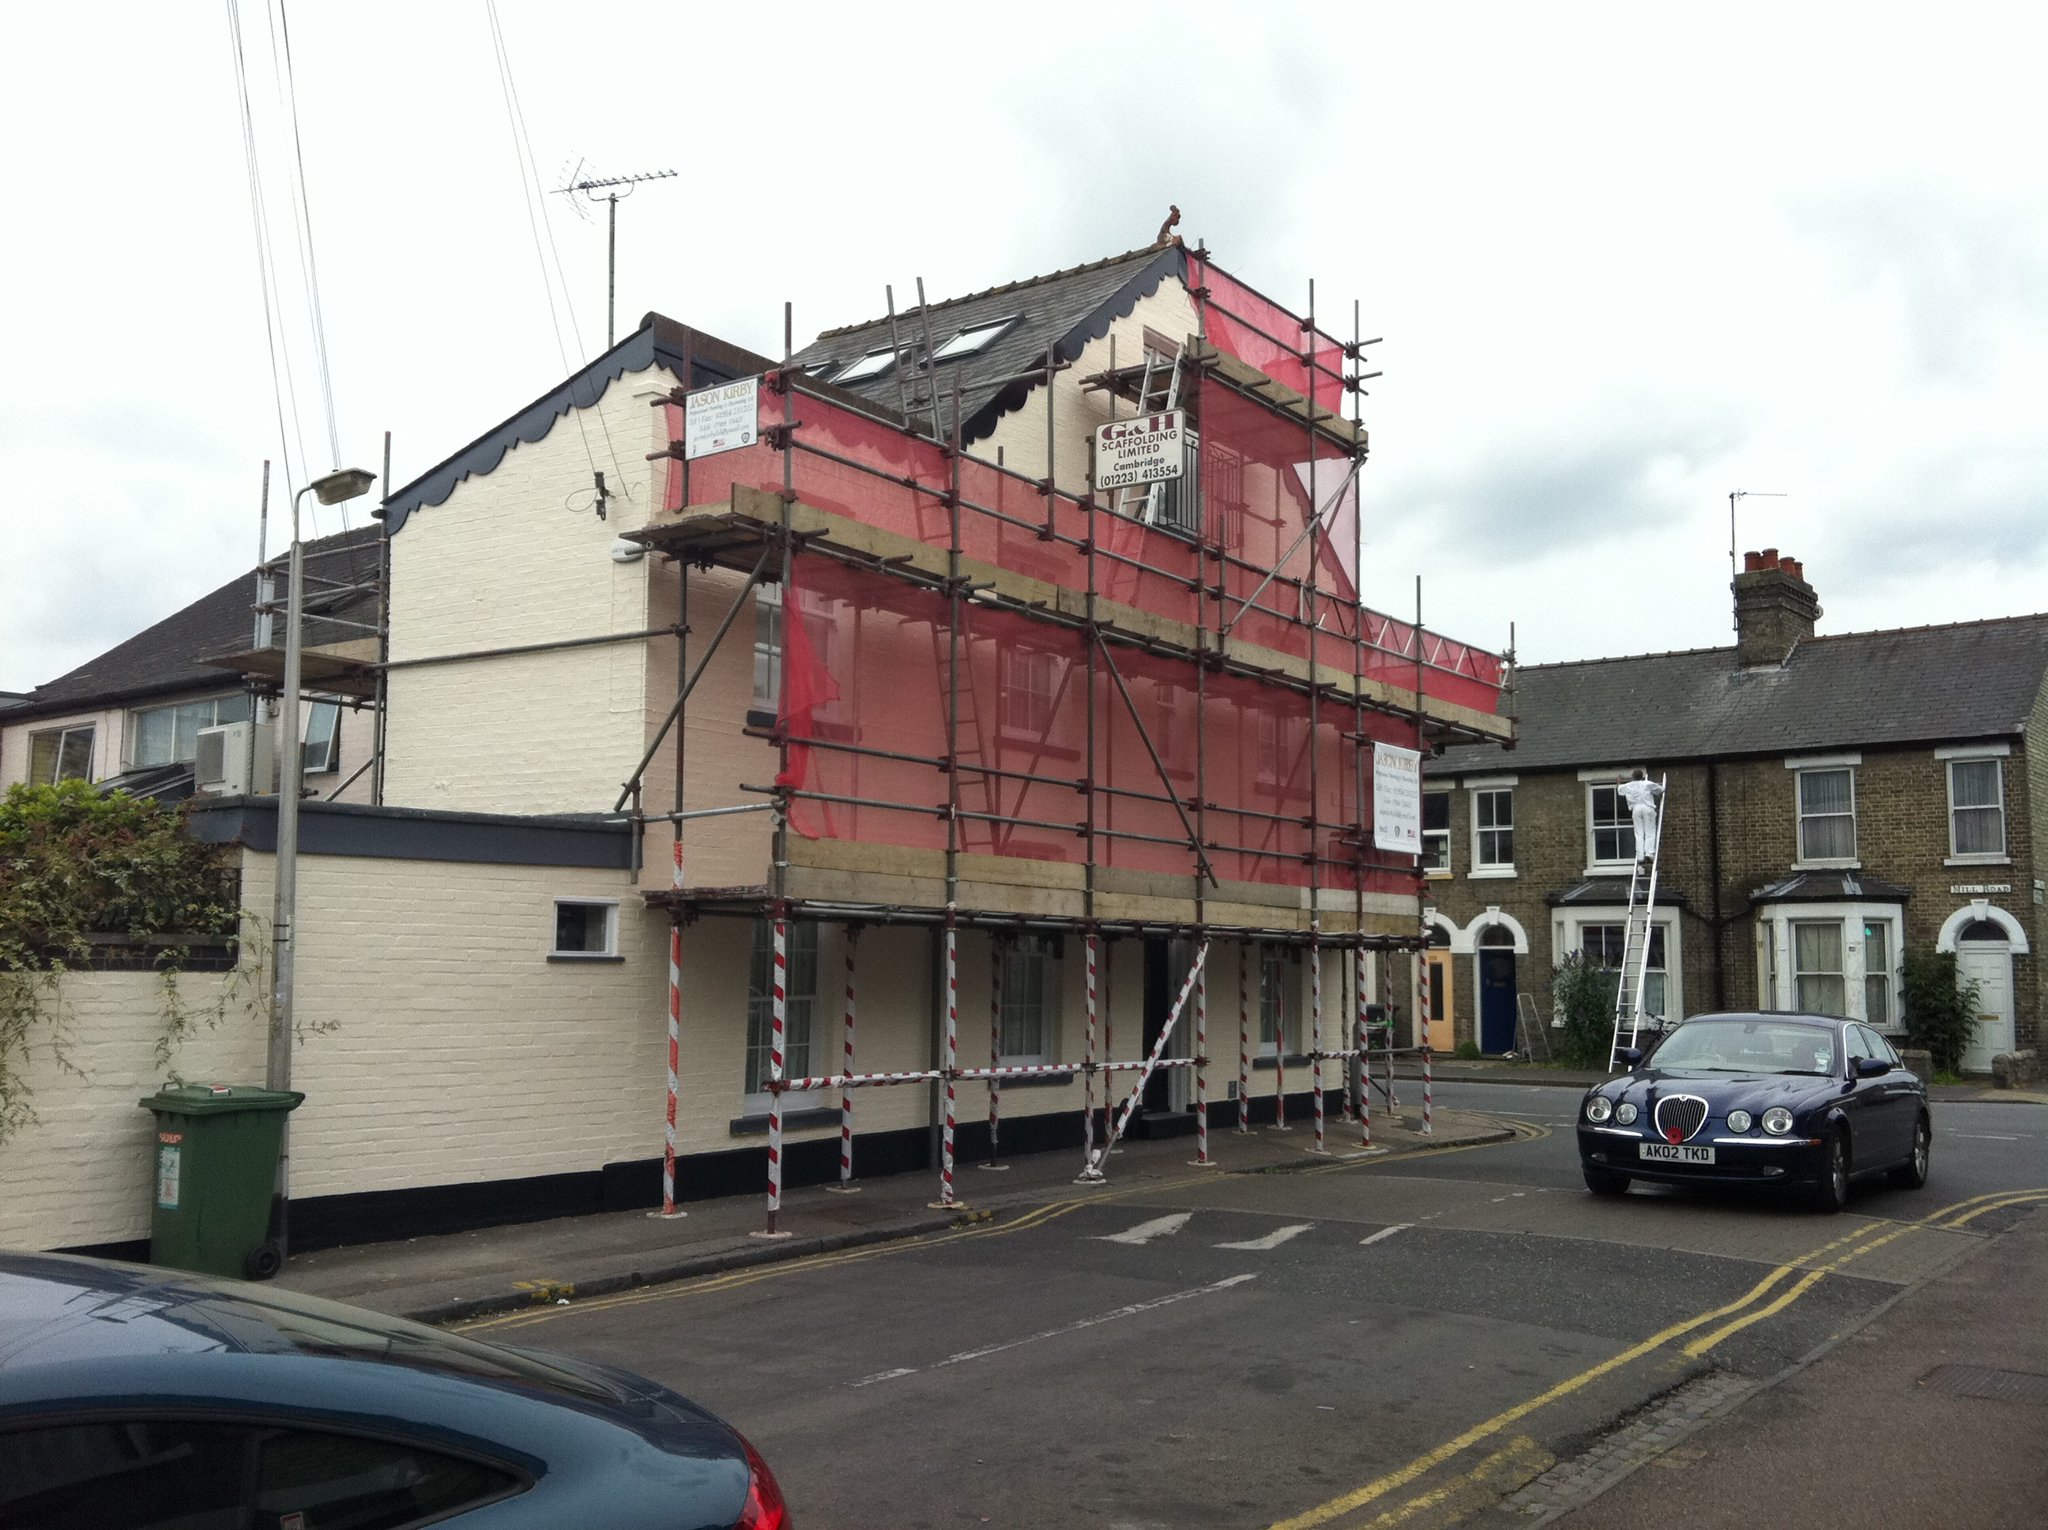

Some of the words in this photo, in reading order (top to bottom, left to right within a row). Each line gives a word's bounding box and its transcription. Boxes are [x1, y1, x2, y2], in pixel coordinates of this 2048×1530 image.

[689, 390, 720, 409] JASON
[723, 381, 753, 400] KIRBY
[1101, 430, 1178, 451] SCAFFOLDING
[1118, 443, 1160, 459] LIMITED
[1113, 457, 1165, 471] Cambridge
[1100, 470, 1138, 487] (01223)
[1142, 464, 1178, 479] 413554
[1953, 884, 1978, 894] MILL
[1983, 884, 2010, 893] ROAD
[1646, 1144, 1679, 1159] AK02
[1682, 1147, 1709, 1160] TKD
